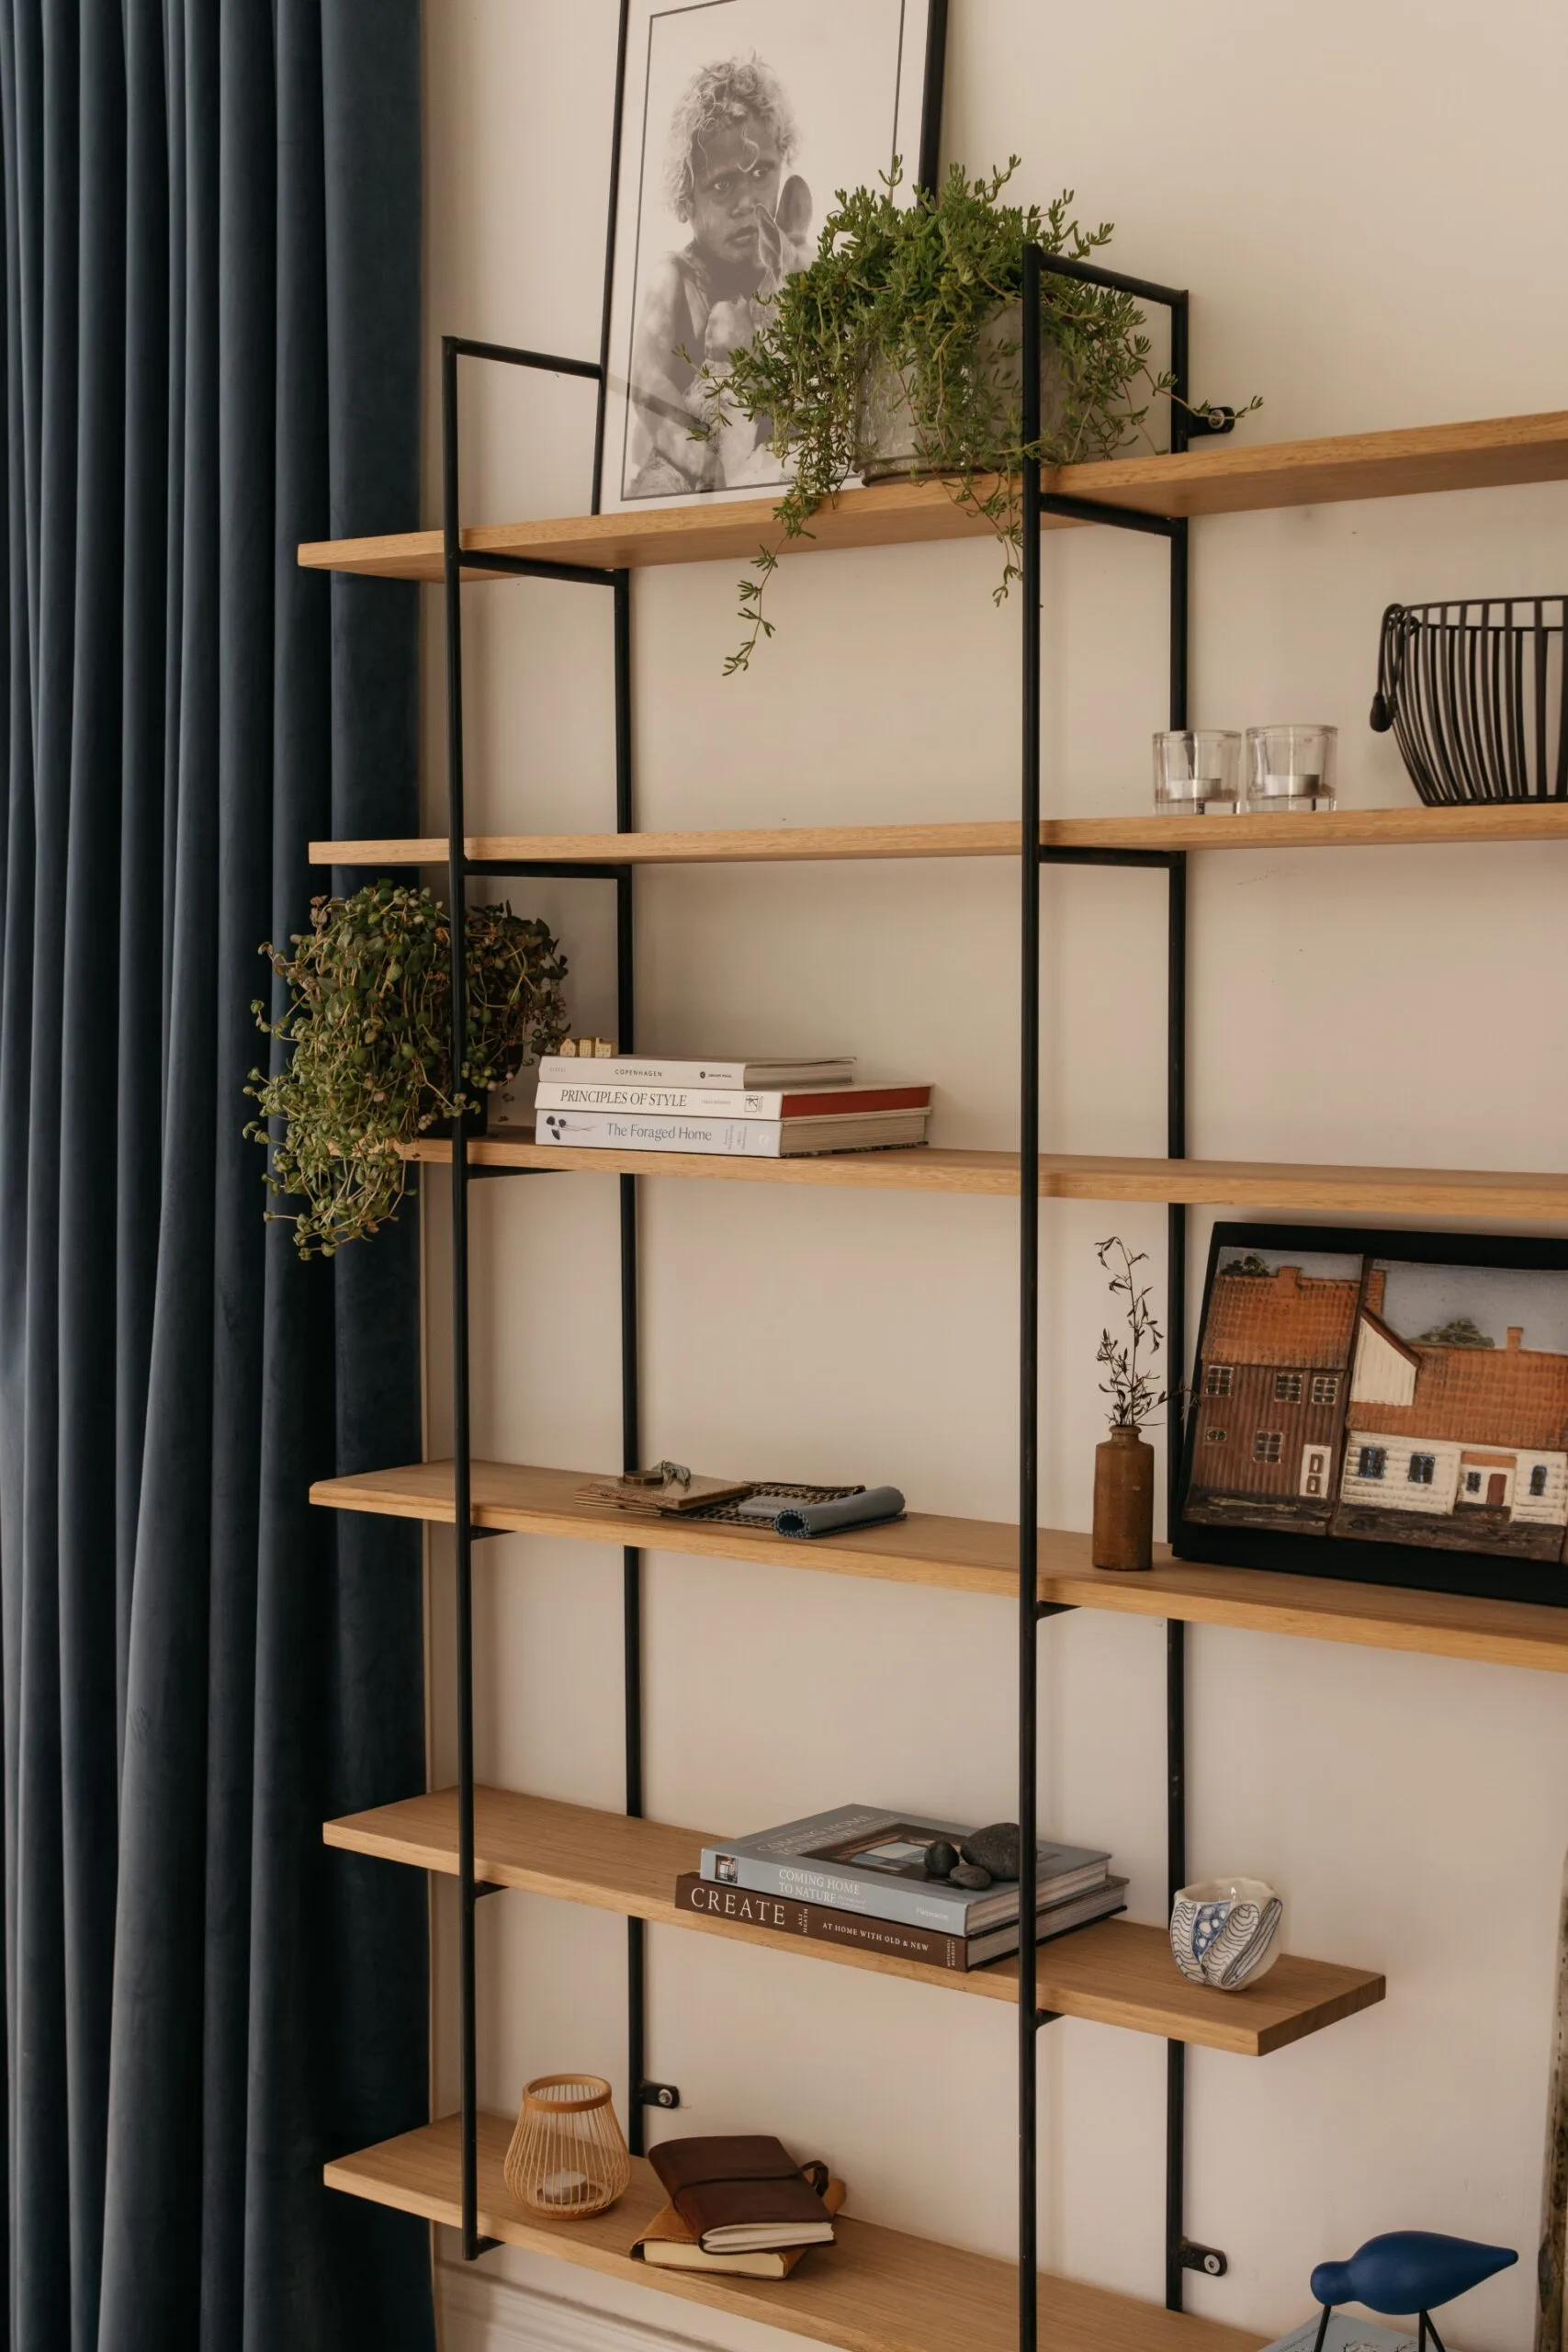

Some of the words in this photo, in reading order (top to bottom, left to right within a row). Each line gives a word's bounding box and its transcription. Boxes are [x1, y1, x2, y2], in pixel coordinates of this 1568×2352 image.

[614, 1069, 662, 1077] COPENHAGEN
[560, 1089, 627, 1103] PRINCIPLES
[630, 1092, 648, 1105] OF
[649, 1093, 687, 1107] STYLE
[607, 1123, 627, 1136] The
[630, 1124, 676, 1142] Foraged
[679, 1126, 712, 1141] Home
[778, 1881, 793, 1894] TO
[795, 1885, 837, 1904] NATURE
[779, 1869, 825, 1888] COMING
[827, 1878, 861, 1895] HOME
[691, 1887, 786, 1926] CREATE
[822, 1922, 833, 1930] AT
[834, 1925, 858, 1936] HOME
[860, 1929, 882, 1941] WITH
[885, 1935, 900, 1945] OLD
[903, 1939, 908, 1948] &
[910, 1941, 930, 1951] NEW
